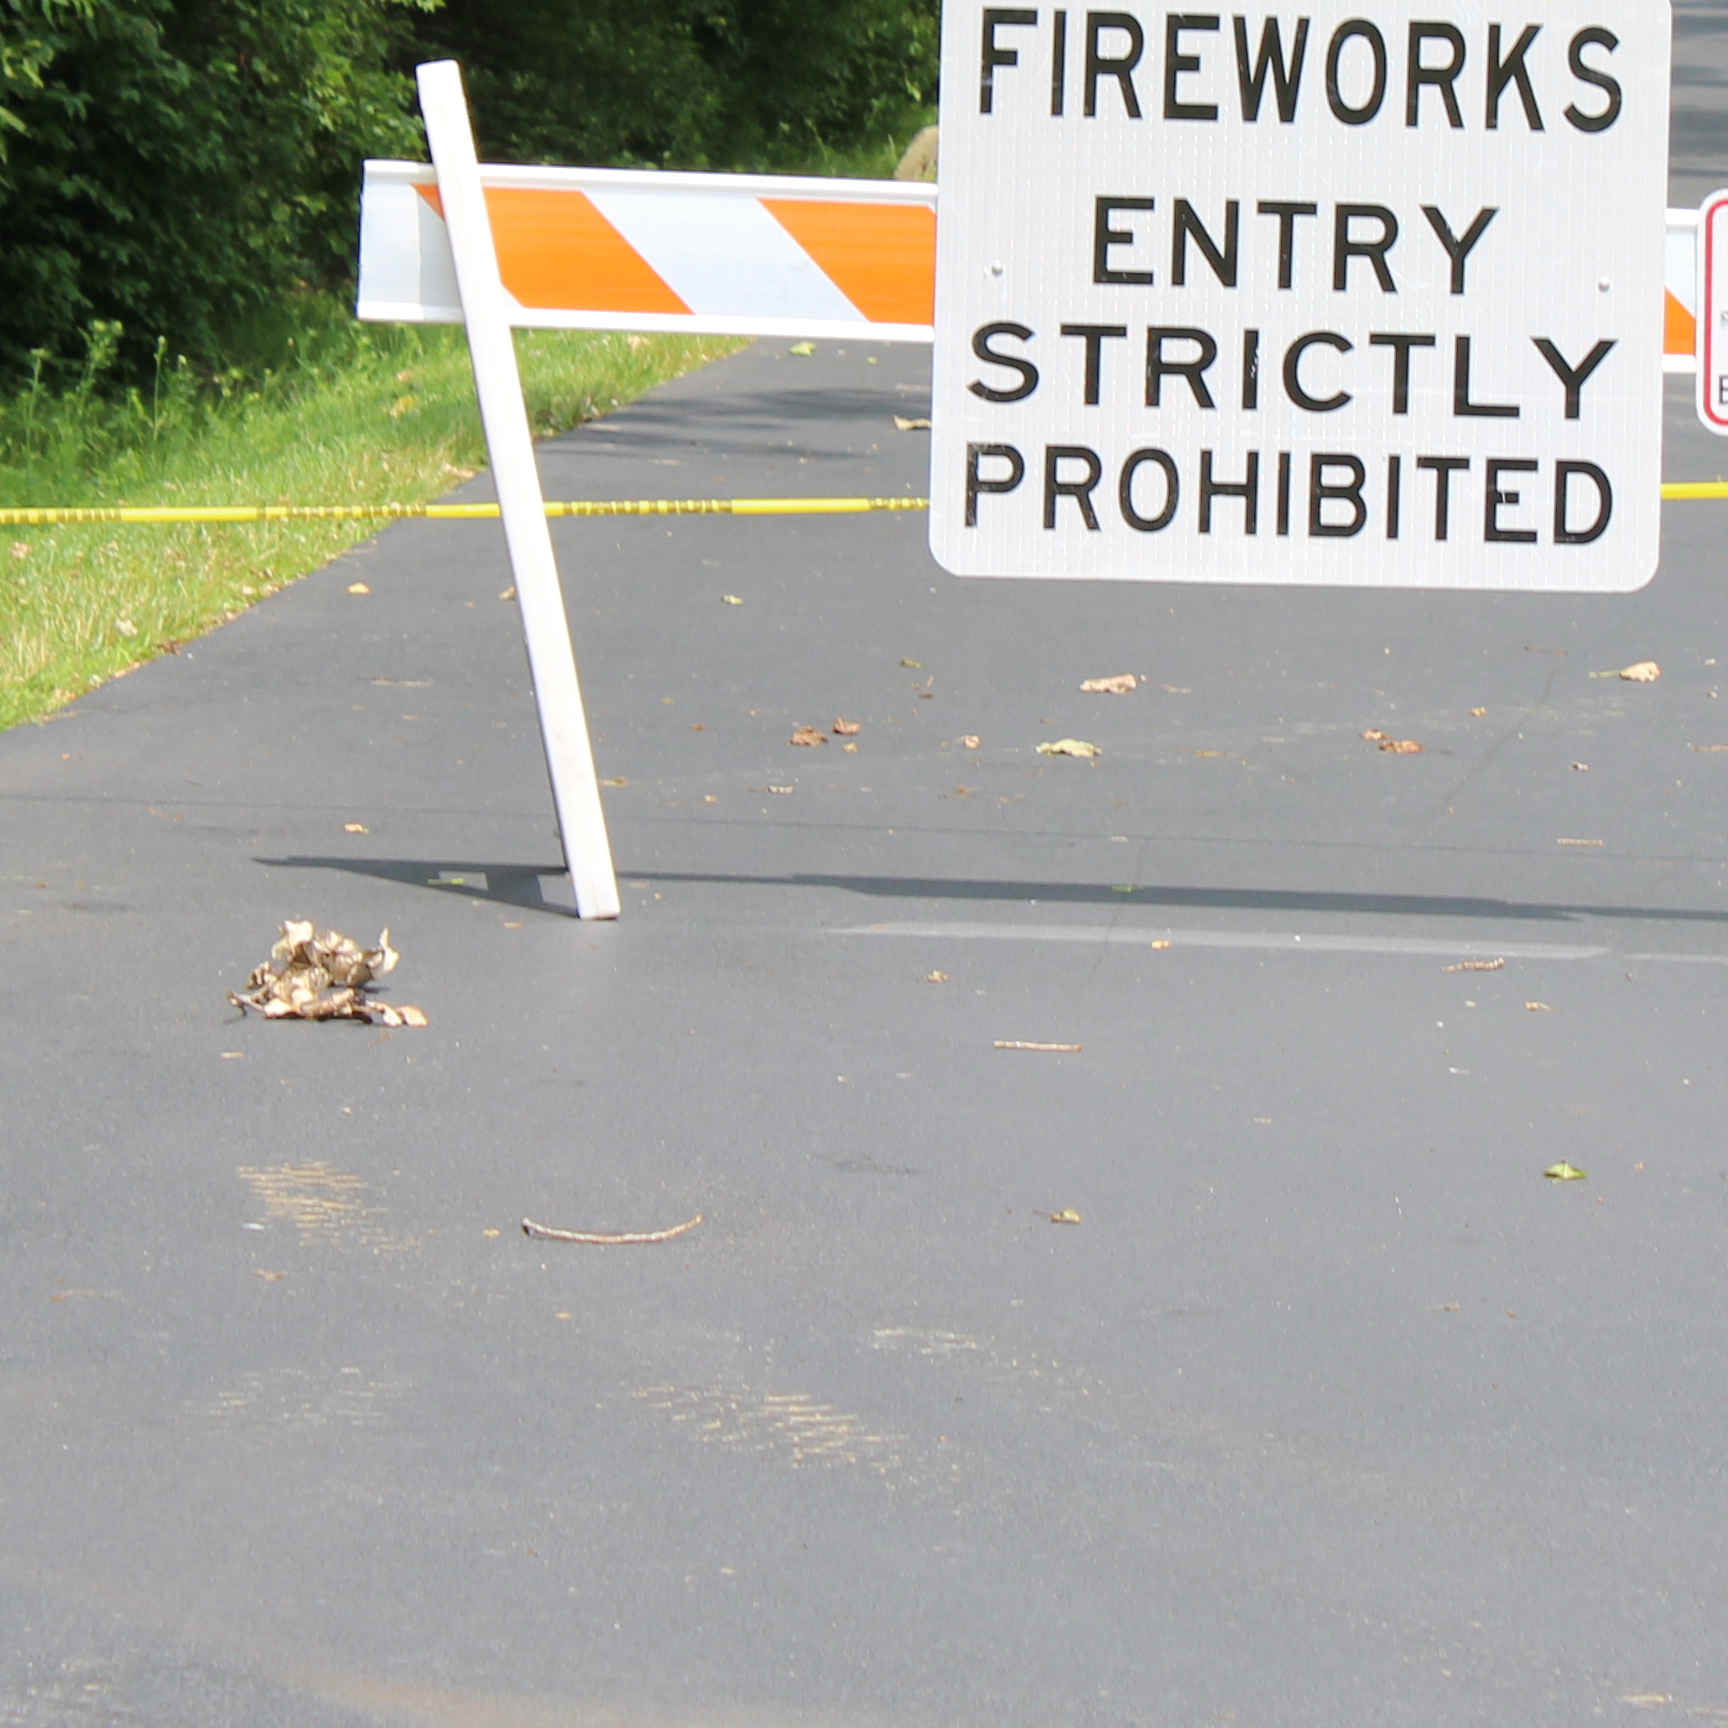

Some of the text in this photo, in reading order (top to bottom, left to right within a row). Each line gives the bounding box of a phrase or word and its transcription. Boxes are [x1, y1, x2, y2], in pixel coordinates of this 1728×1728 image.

[979, 8, 1622, 133] FIREWORKS
[1093, 196, 1499, 295] ENTRY
[967, 322, 1619, 421] STRICTLY
[964, 443, 1614, 546] PROHIBITED
